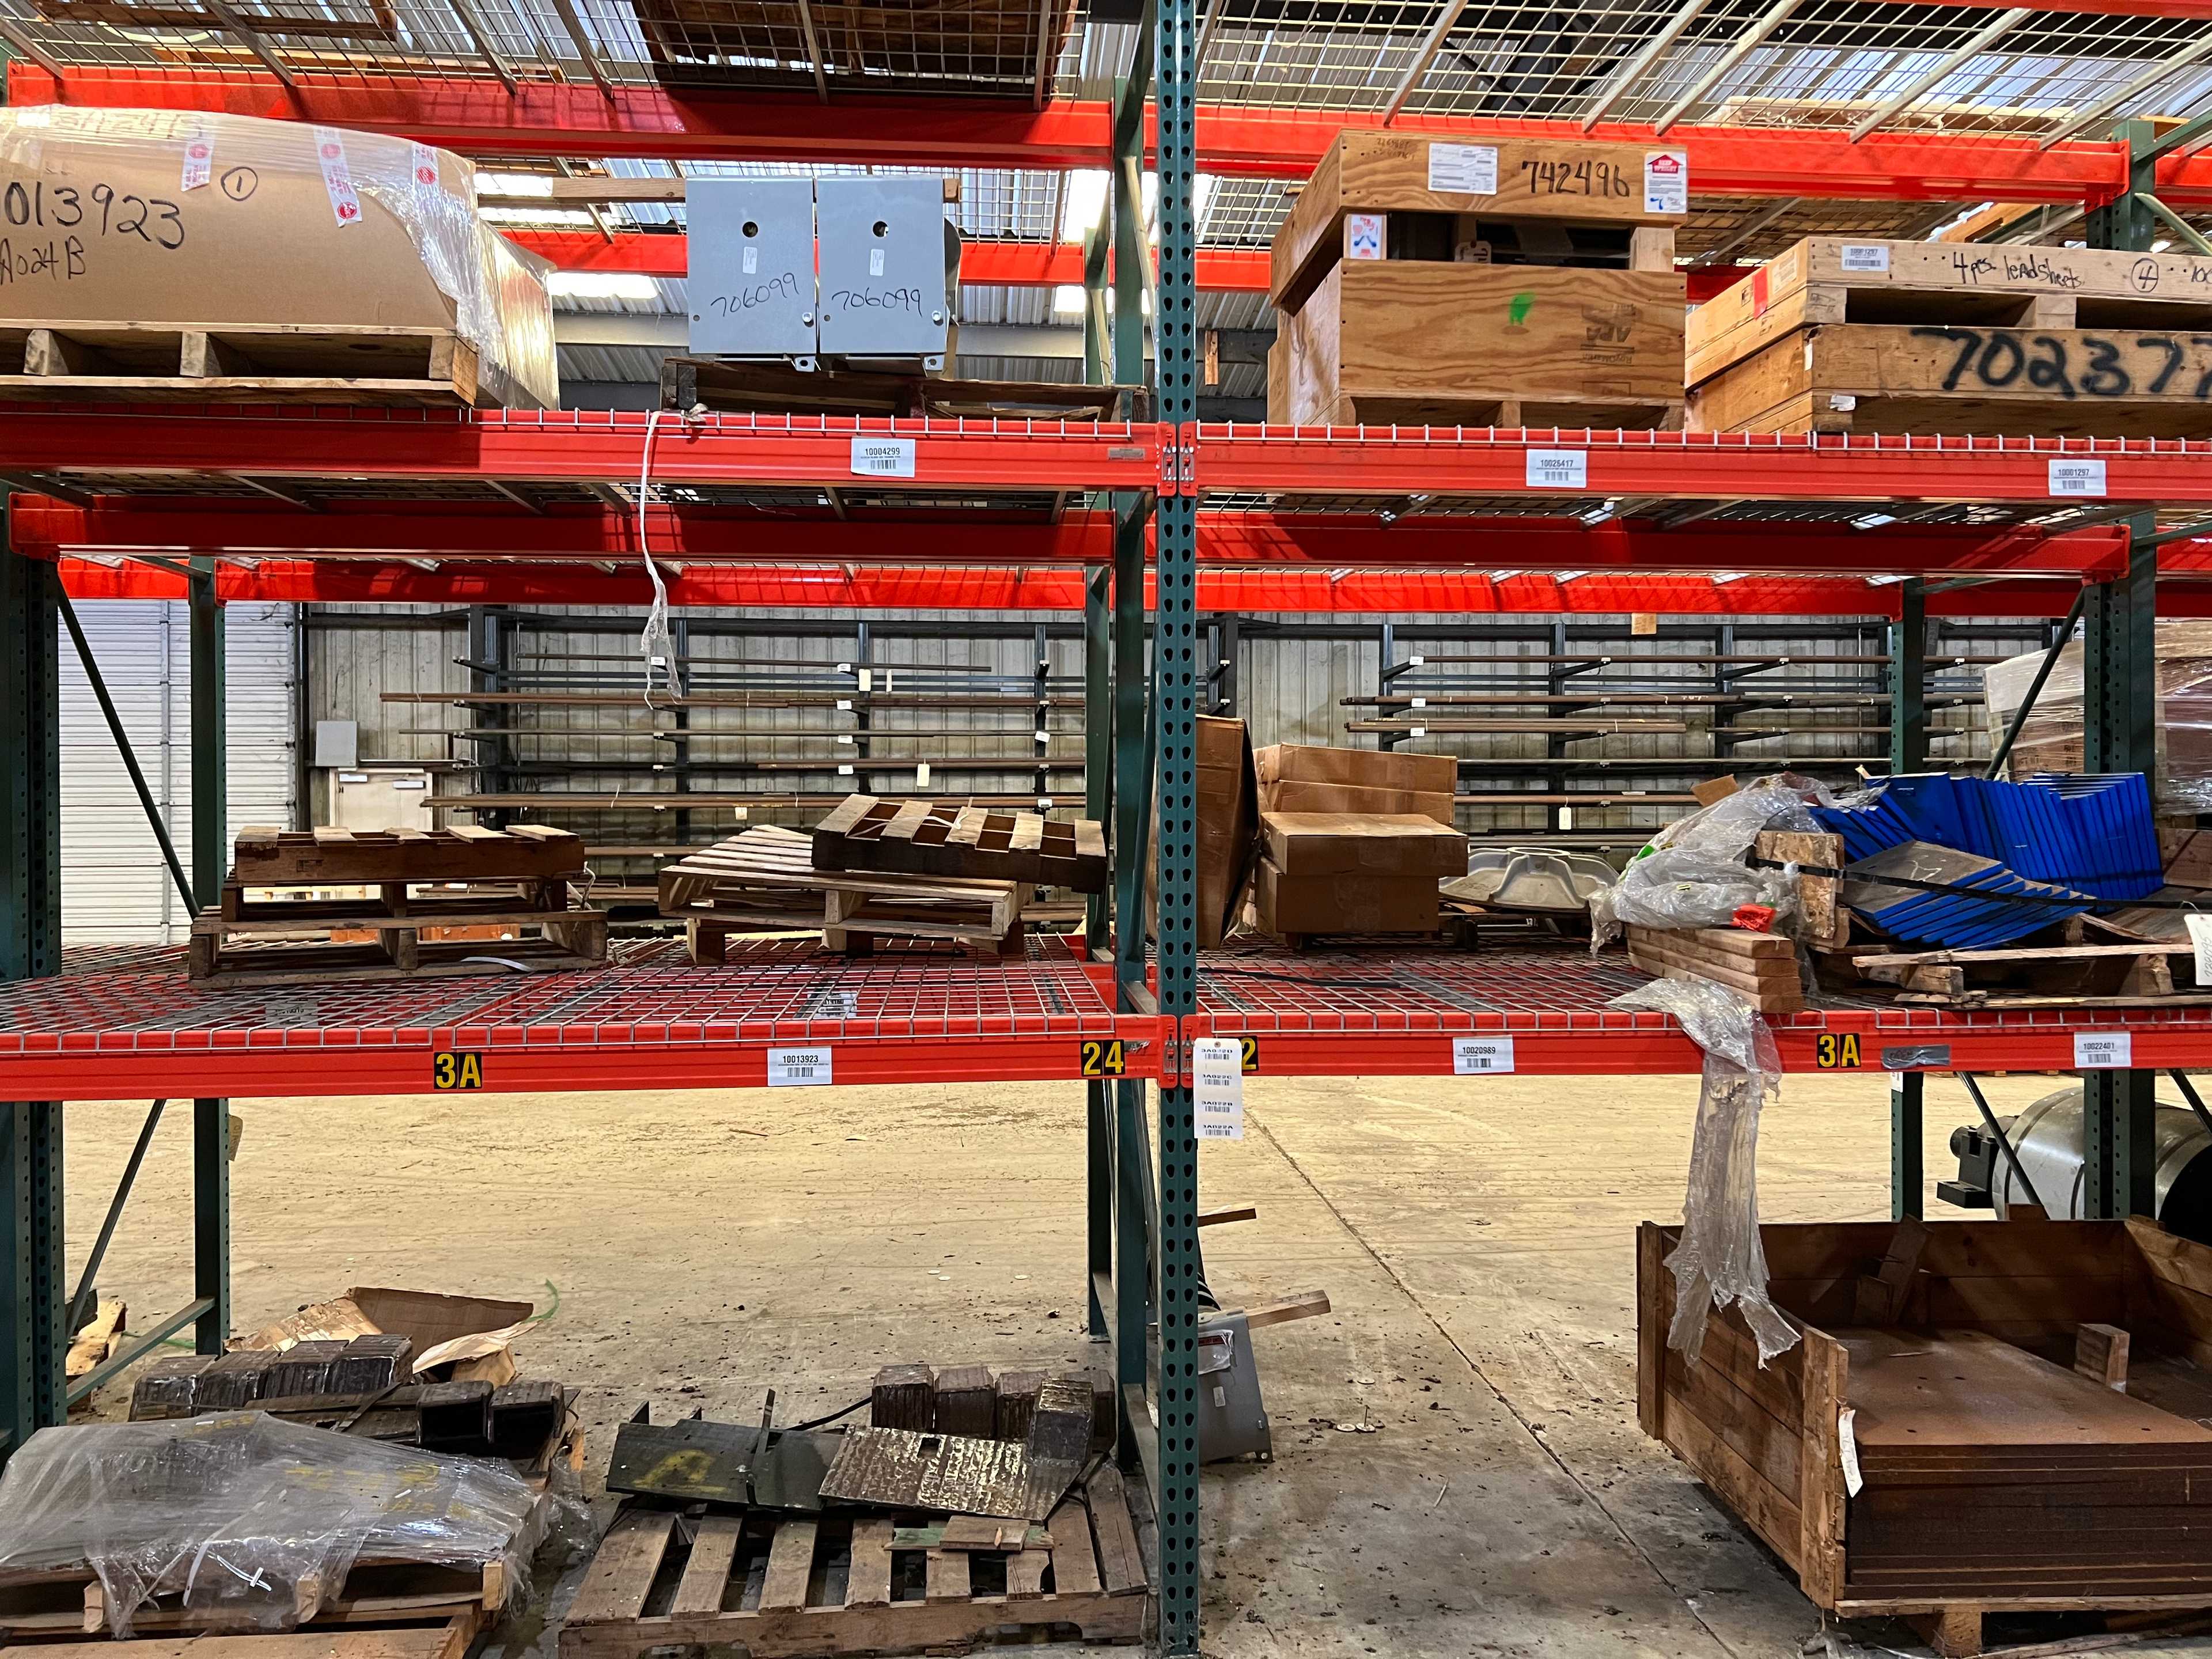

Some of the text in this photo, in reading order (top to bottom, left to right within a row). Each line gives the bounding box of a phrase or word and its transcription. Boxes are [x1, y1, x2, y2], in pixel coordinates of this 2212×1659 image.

[1521, 160, 1630, 197] 742496
[4, 181, 185, 249] 013923
[711, 272, 800, 317] 706099
[832, 287, 922, 318] 706099
[865, 447, 900, 456] 10004299
[783, 1055, 819, 1063] 10013923
[1083, 1041, 1123, 1076] 24
[1819, 1035, 1861, 1067] 3A
[2084, 1042, 2115, 1050] 10022401
[436, 1053, 482, 1089] 3A
